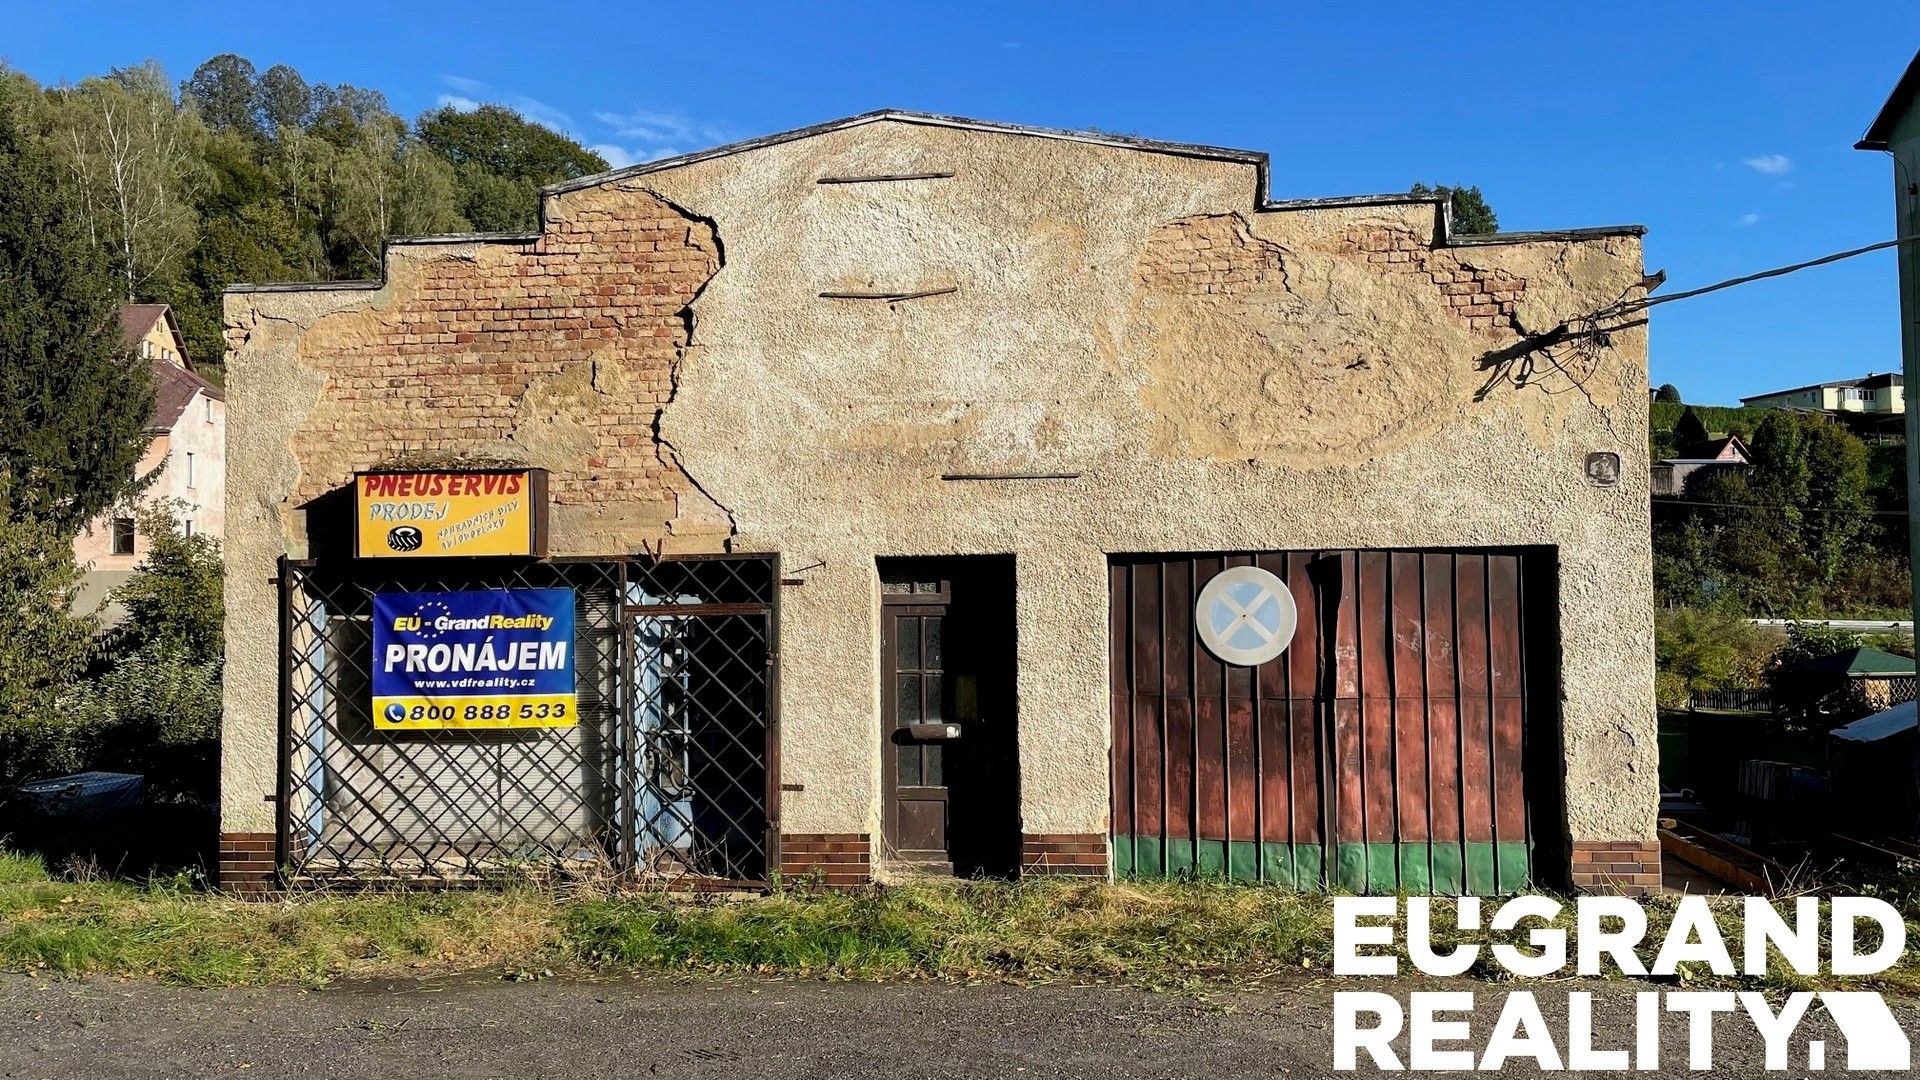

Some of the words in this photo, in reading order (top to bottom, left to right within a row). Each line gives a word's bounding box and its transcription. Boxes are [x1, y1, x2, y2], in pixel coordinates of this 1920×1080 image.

[365, 474, 524, 497] PNEUSERVIS
[370, 502, 448, 521] PRODEJ
[393, 616, 421, 631] EU
[434, 614, 553, 632] GrandReality
[384, 636, 567, 673] PRONÁJEM
[414, 677, 536, 688] www.vdfreality.cz
[410, 705, 456, 721] 800
[464, 704, 511, 720] 888
[519, 704, 566, 719] 533
